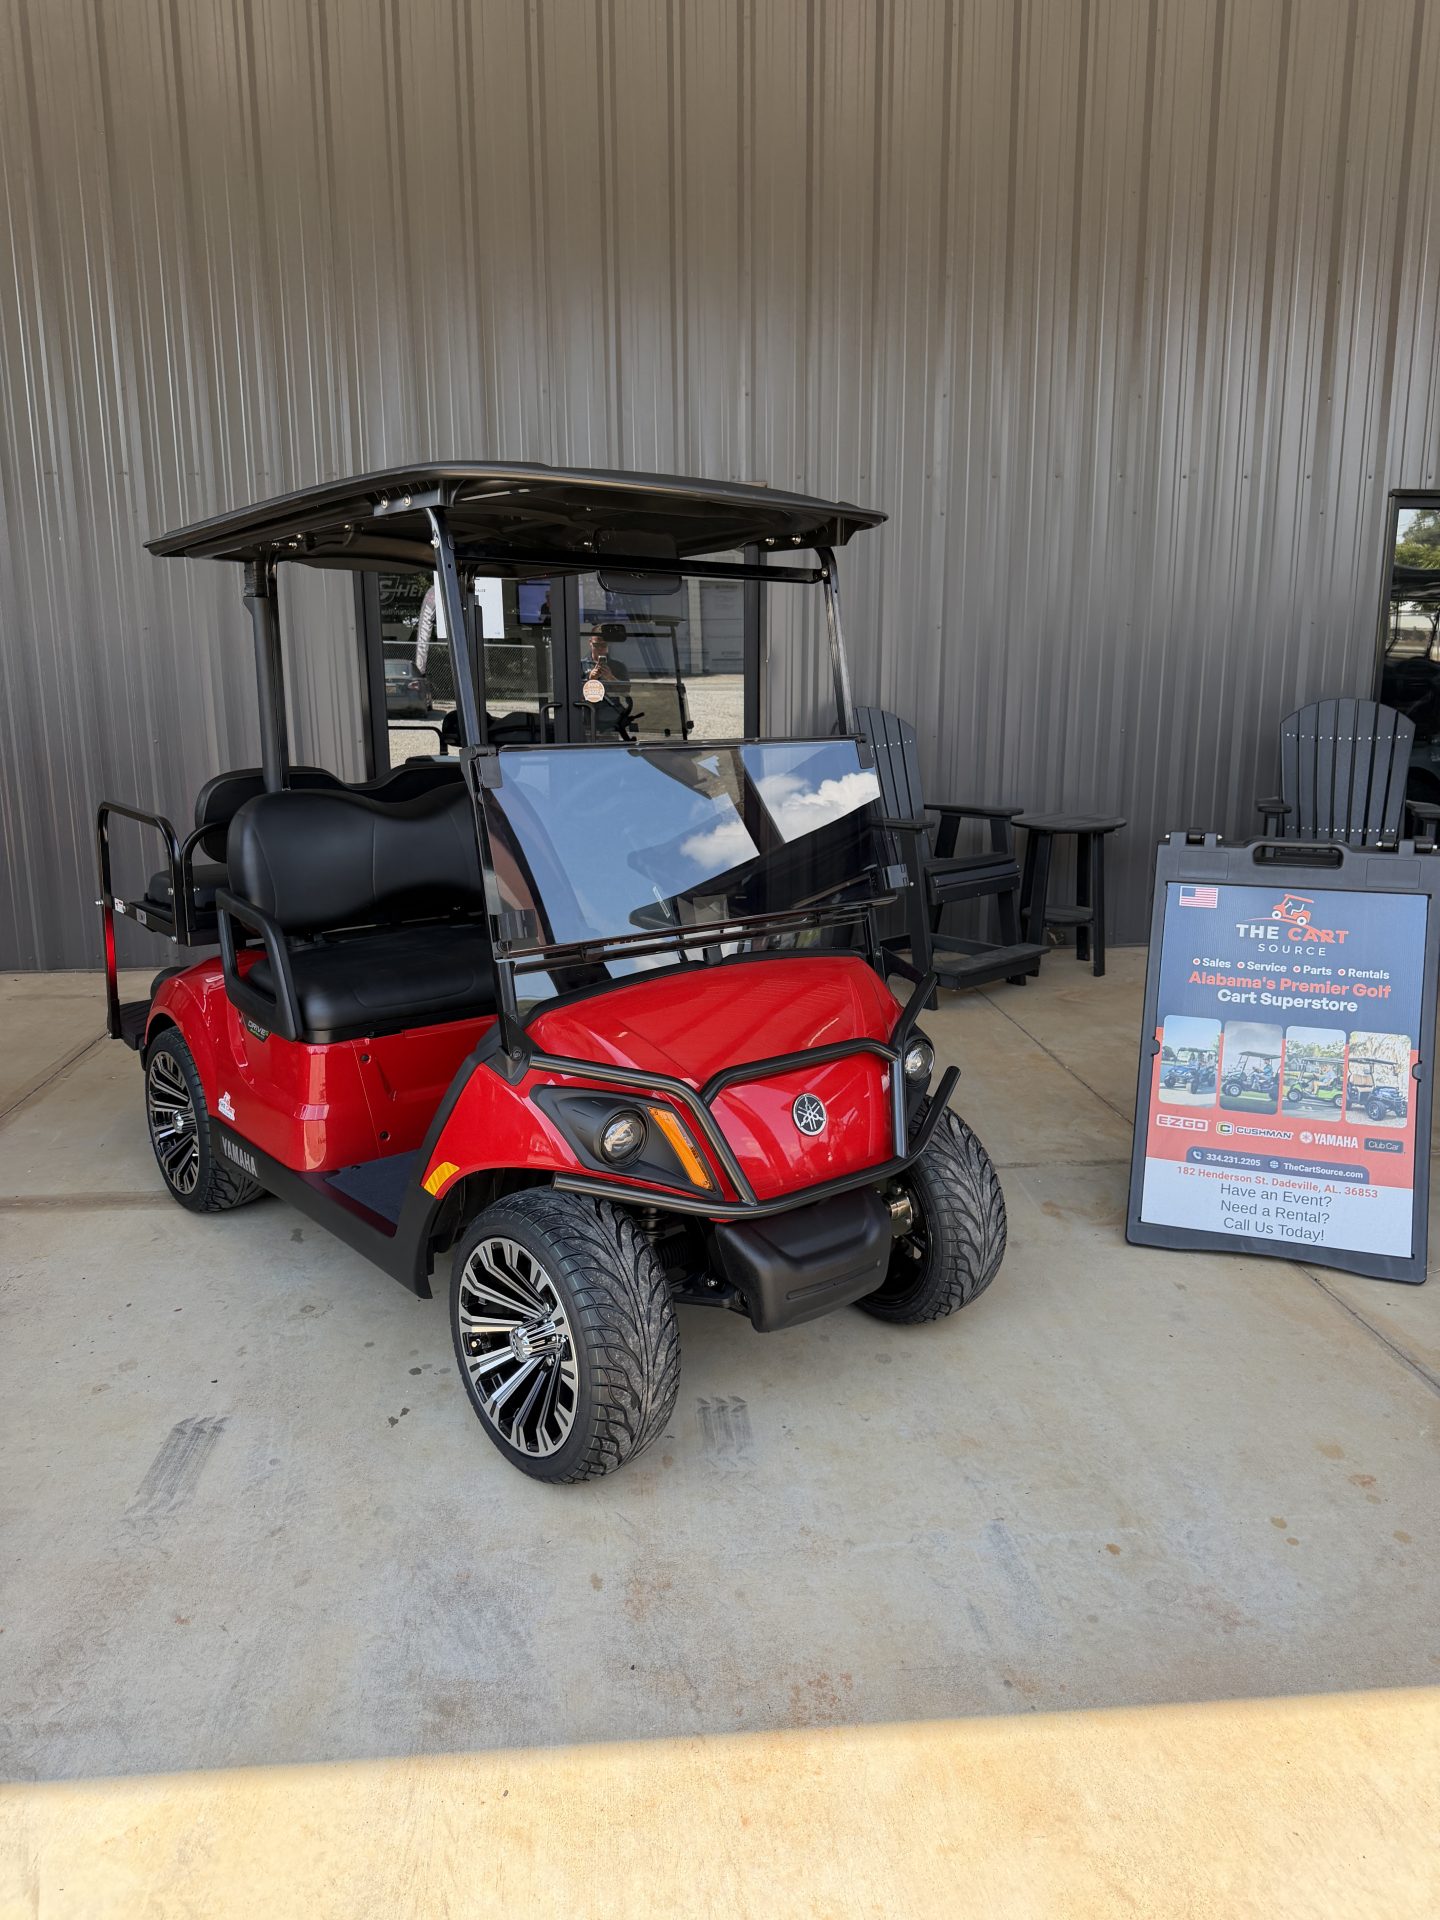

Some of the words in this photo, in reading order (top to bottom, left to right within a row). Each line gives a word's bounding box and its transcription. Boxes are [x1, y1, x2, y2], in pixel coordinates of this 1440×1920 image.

[1235, 924, 1280, 939] THE
[1287, 927, 1350, 944] CART
[1257, 943, 1327, 956] SOURCE
[1202, 958, 1231, 968] Sales
[1247, 961, 1287, 973] Service
[1303, 965, 1332, 976] Parts
[1348, 968, 1390, 980] Rentals
[1188, 971, 1276, 989] Alabama's
[1280, 977, 1350, 996] Premier
[1352, 983, 1392, 999] Golf
[1217, 988, 1257, 1004] Cart
[1260, 992, 1358, 1012] Superstore
[1158, 1115, 1207, 1130] EZGO
[1236, 1127, 1292, 1139] CUSHMAN
[1313, 1133, 1359, 1148] YAMAHA
[221, 1135, 258, 1177] YAMAHA
[1206, 1153, 1261, 1166] 334.231.2205
[1283, 1162, 1364, 1179] TheCartSource.com
[1177, 1166, 1196, 1176] 182
[1199, 1168, 1252, 1184] Henderson
[1255, 1175, 1268, 1185] St.
[1272, 1177, 1321, 1193] Dadeville,
[1324, 1185, 1342, 1195] AL.
[1344, 1186, 1378, 1198] 36853
[1220, 1183, 1256, 1198] Have
[1260, 1189, 1278, 1201] an
[1283, 1191, 1333, 1208] Event?
[1220, 1199, 1257, 1215] Need
[1262, 1206, 1270, 1217] a
[1275, 1207, 1330, 1225] Rental?
[1223, 1217, 1250, 1231] Call
[1255, 1221, 1274, 1234] Us
[1278, 1223, 1324, 1243] Today!
